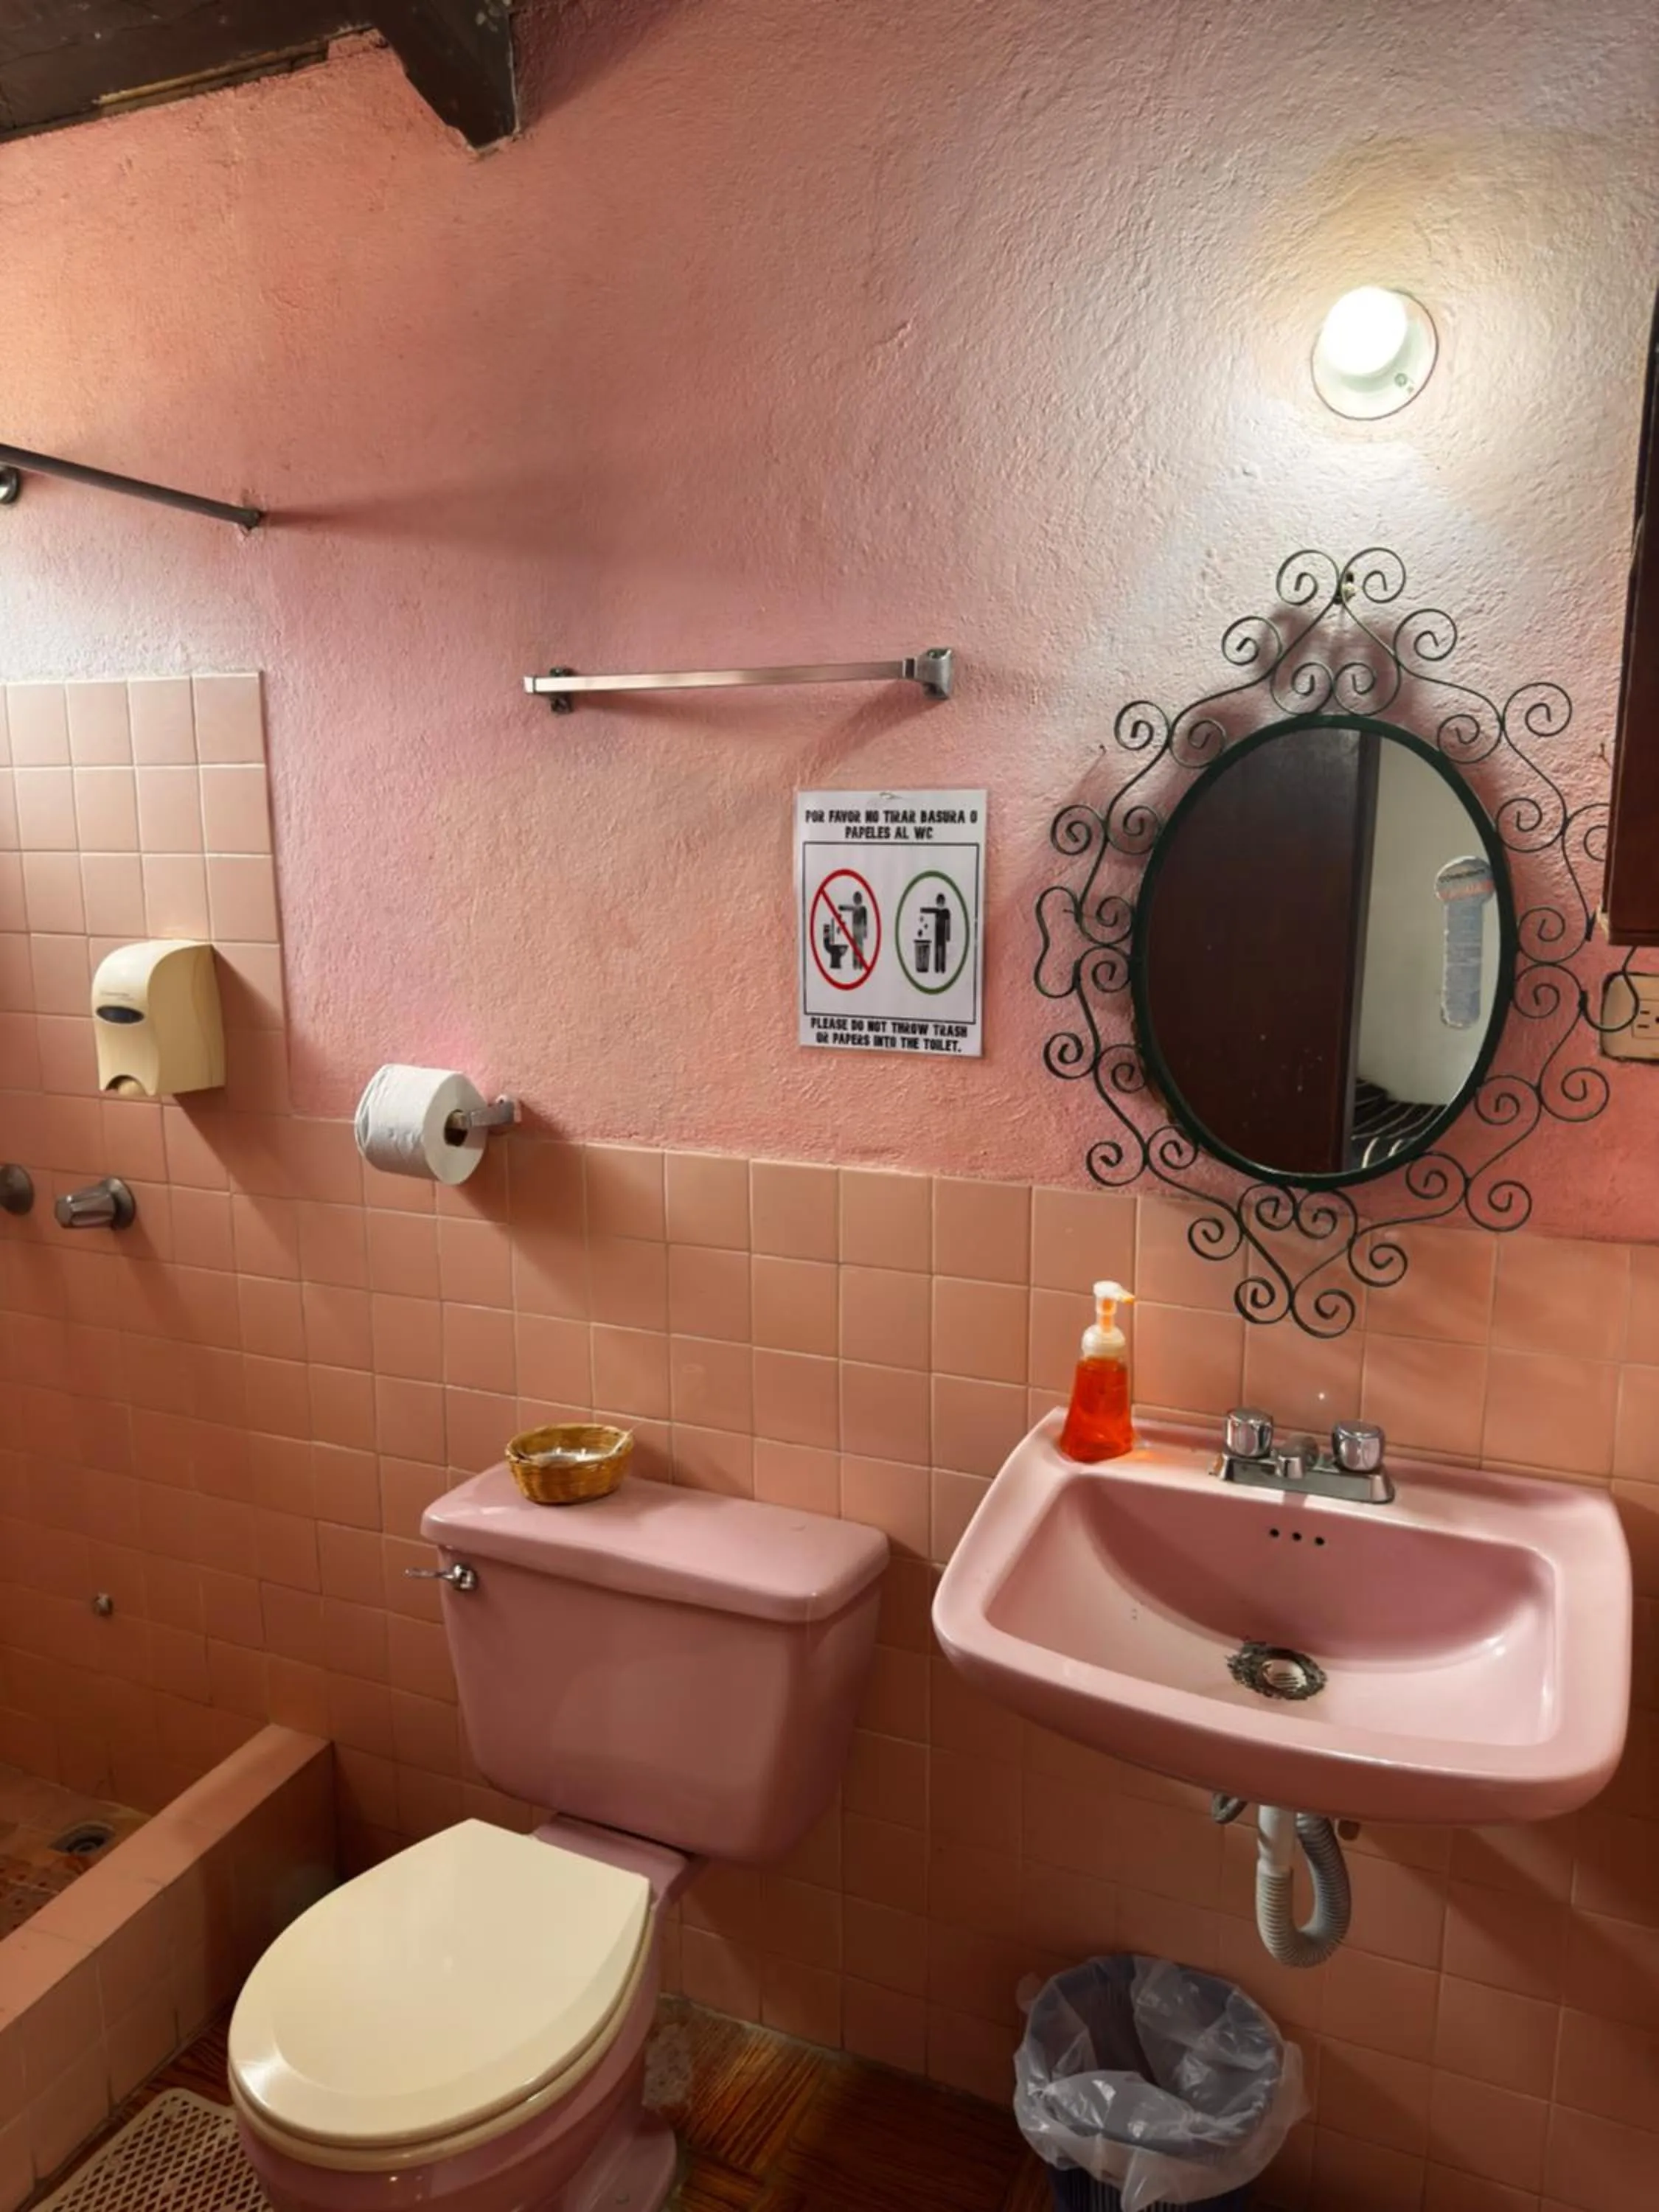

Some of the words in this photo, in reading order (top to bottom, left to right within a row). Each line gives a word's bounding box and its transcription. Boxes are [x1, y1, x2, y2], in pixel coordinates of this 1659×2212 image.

[805, 810, 824, 823] POR
[829, 810, 860, 823] FAVOR
[865, 810, 879, 823] NO
[883, 810, 916, 823] TIRAR
[920, 810, 964, 823] BASURA
[970, 810, 977, 823] O
[845, 827, 891, 839] PAPELES
[894, 827, 908, 839] AL
[914, 827, 933, 839] WC
[811, 1018, 847, 1030] PLEASE
[852, 1019, 864, 1031] DO
[868, 1020, 886, 1032] NOT
[891, 1022, 928, 1036] THROW
[933, 1025, 967, 1037] TRASH
[816, 1032, 828, 1043] OR
[833, 1033, 870, 1046] PAPERS
[874, 1036, 897, 1048] INTO
[901, 1037, 919, 1050] THE
[923, 1039, 961, 1052] TOILET.
